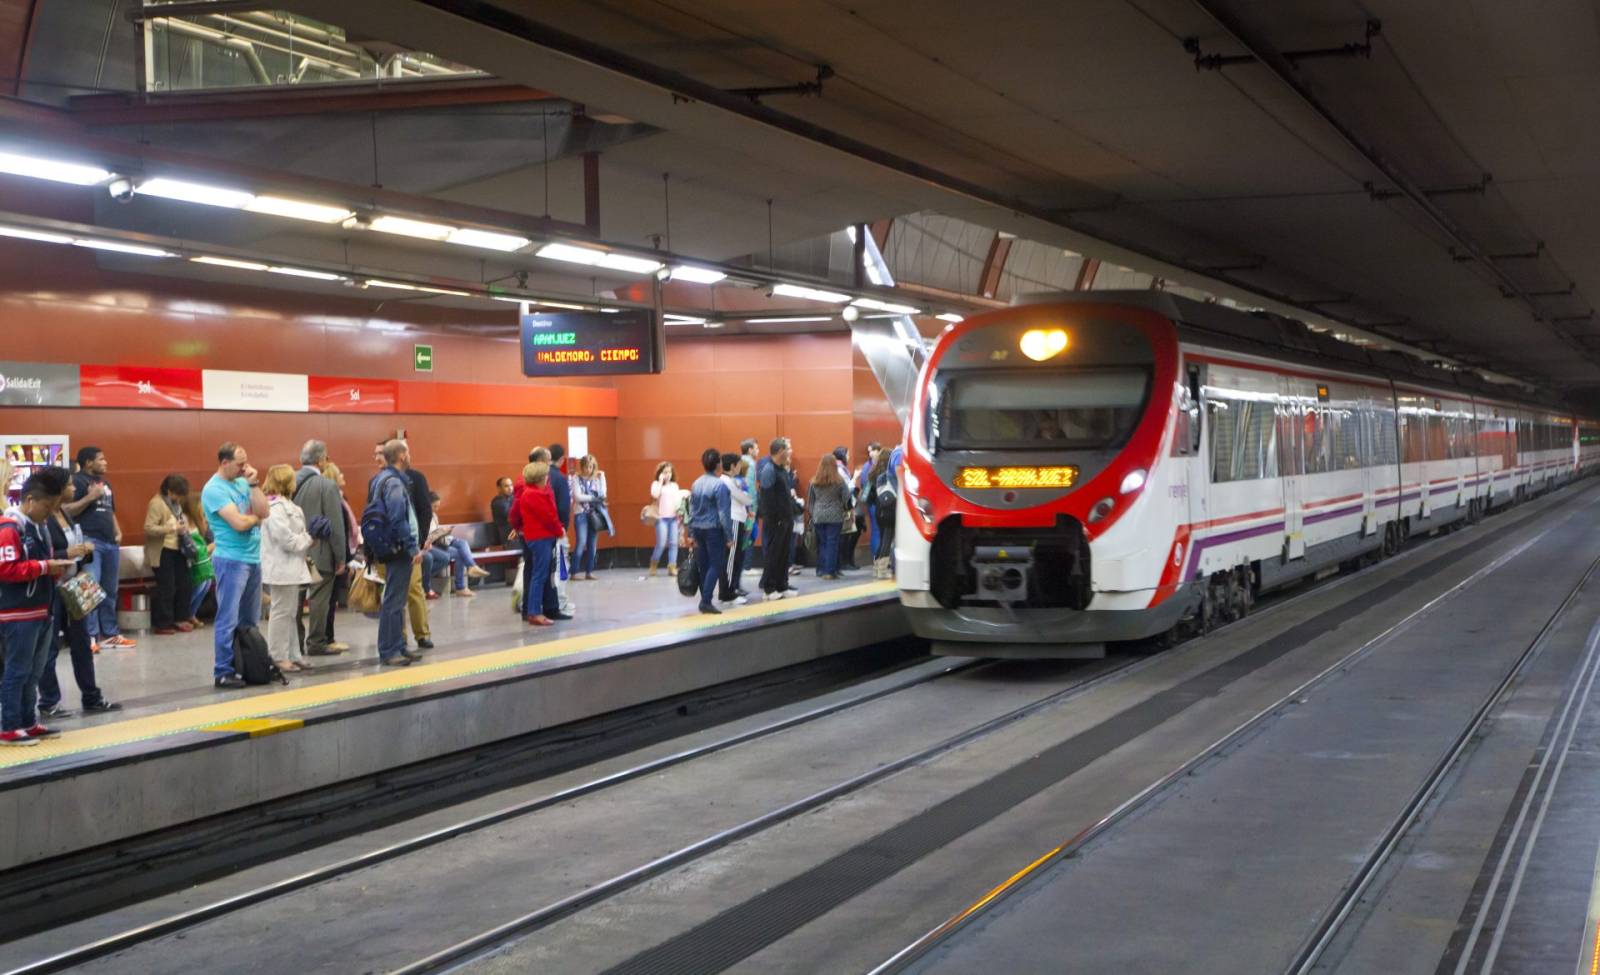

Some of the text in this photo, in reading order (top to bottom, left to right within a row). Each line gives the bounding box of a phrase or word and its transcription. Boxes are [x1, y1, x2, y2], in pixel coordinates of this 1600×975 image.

[533, 332, 576, 345] ARANJUEZ
[137, 380, 151, 394] Sol
[350, 388, 360, 401] Sol
